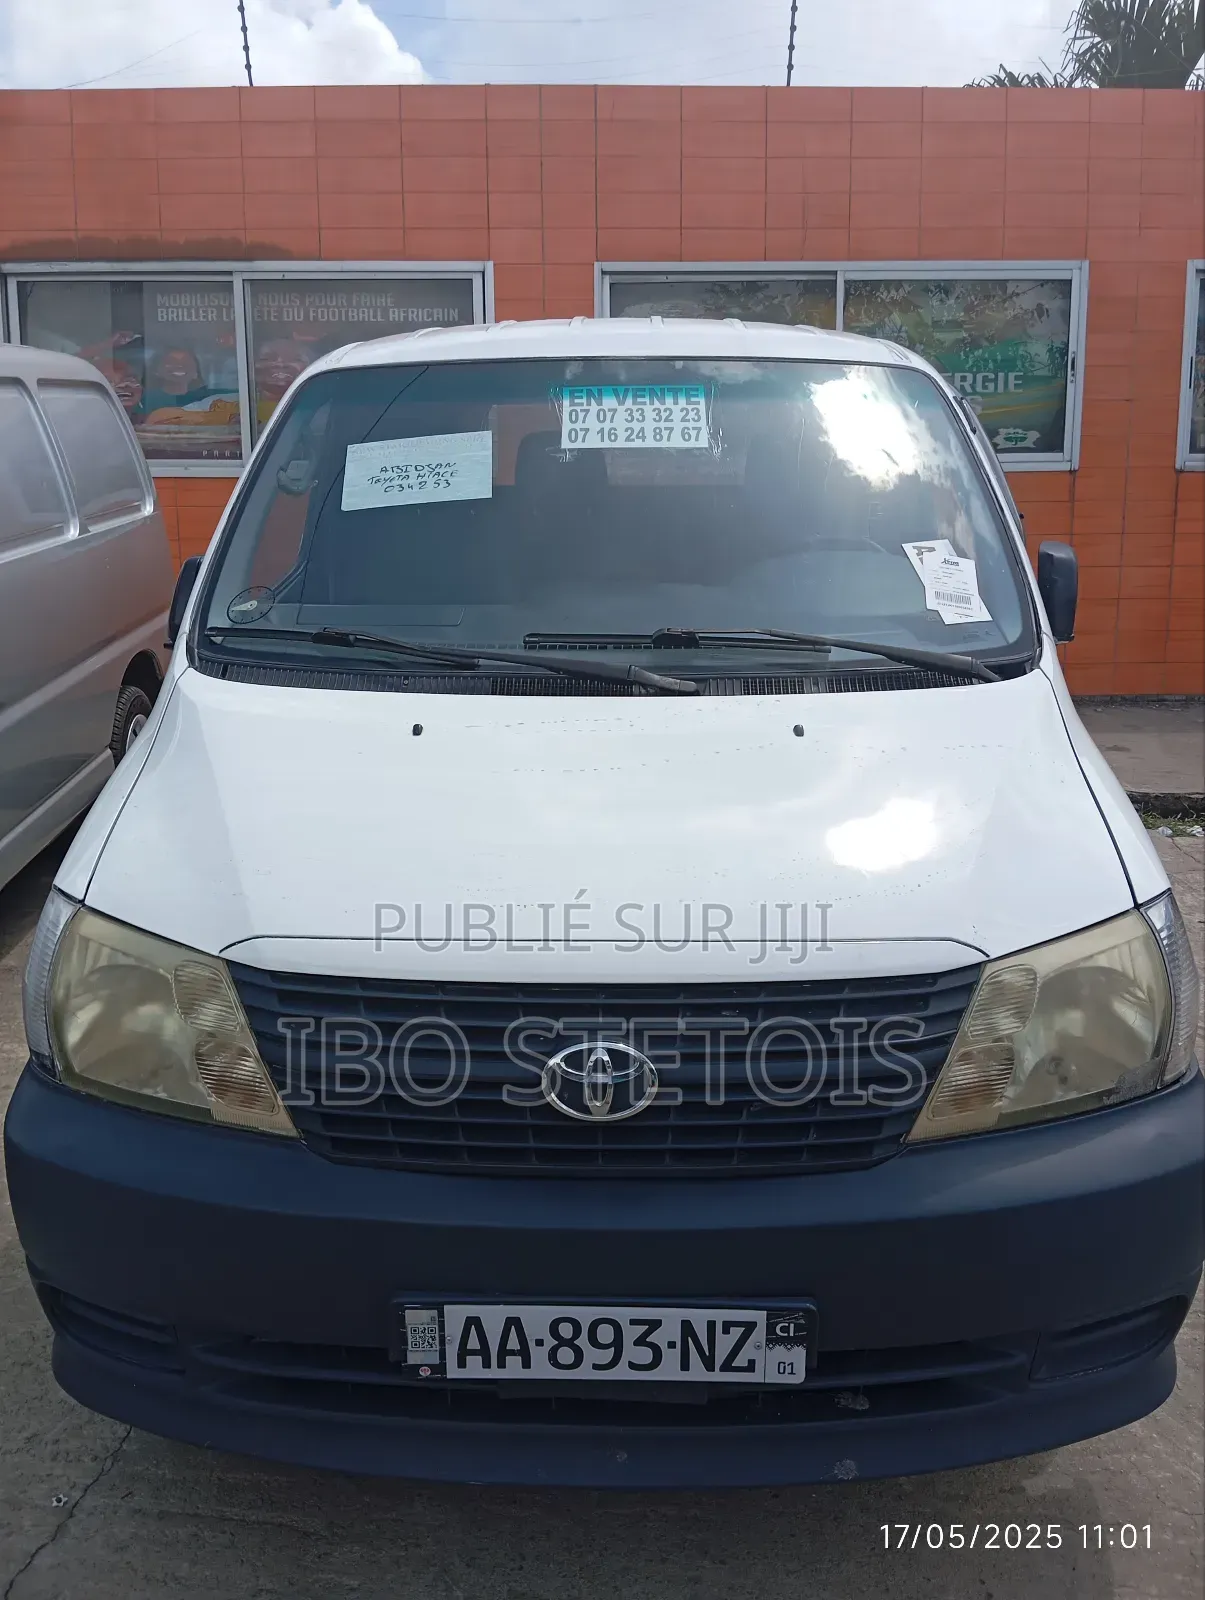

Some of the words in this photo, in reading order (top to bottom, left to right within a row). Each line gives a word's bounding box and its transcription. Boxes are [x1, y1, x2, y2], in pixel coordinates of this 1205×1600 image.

[306, 292, 347, 307] POUR
[157, 308, 217, 322] BRILLER
[283, 308, 304, 322] DU
[309, 308, 385, 322] FOOTBALL
[389, 308, 459, 322] AFRICAIN
[569, 387, 603, 407] EN
[612, 387, 701, 406] VENTE
[568, 408, 590, 424] 07
[596, 408, 618, 424] 07
[624, 407, 646, 423] 33
[652, 407, 674, 423] 32
[679, 407, 702, 423] 23
[567, 427, 590, 443] 07
[596, 427, 618, 443] 16
[624, 427, 647, 442] 24
[652, 426, 675, 442] 87
[680, 426, 702, 442] 67
[775, 1322, 795, 1337] CI
[777, 1361, 797, 1376] 01
